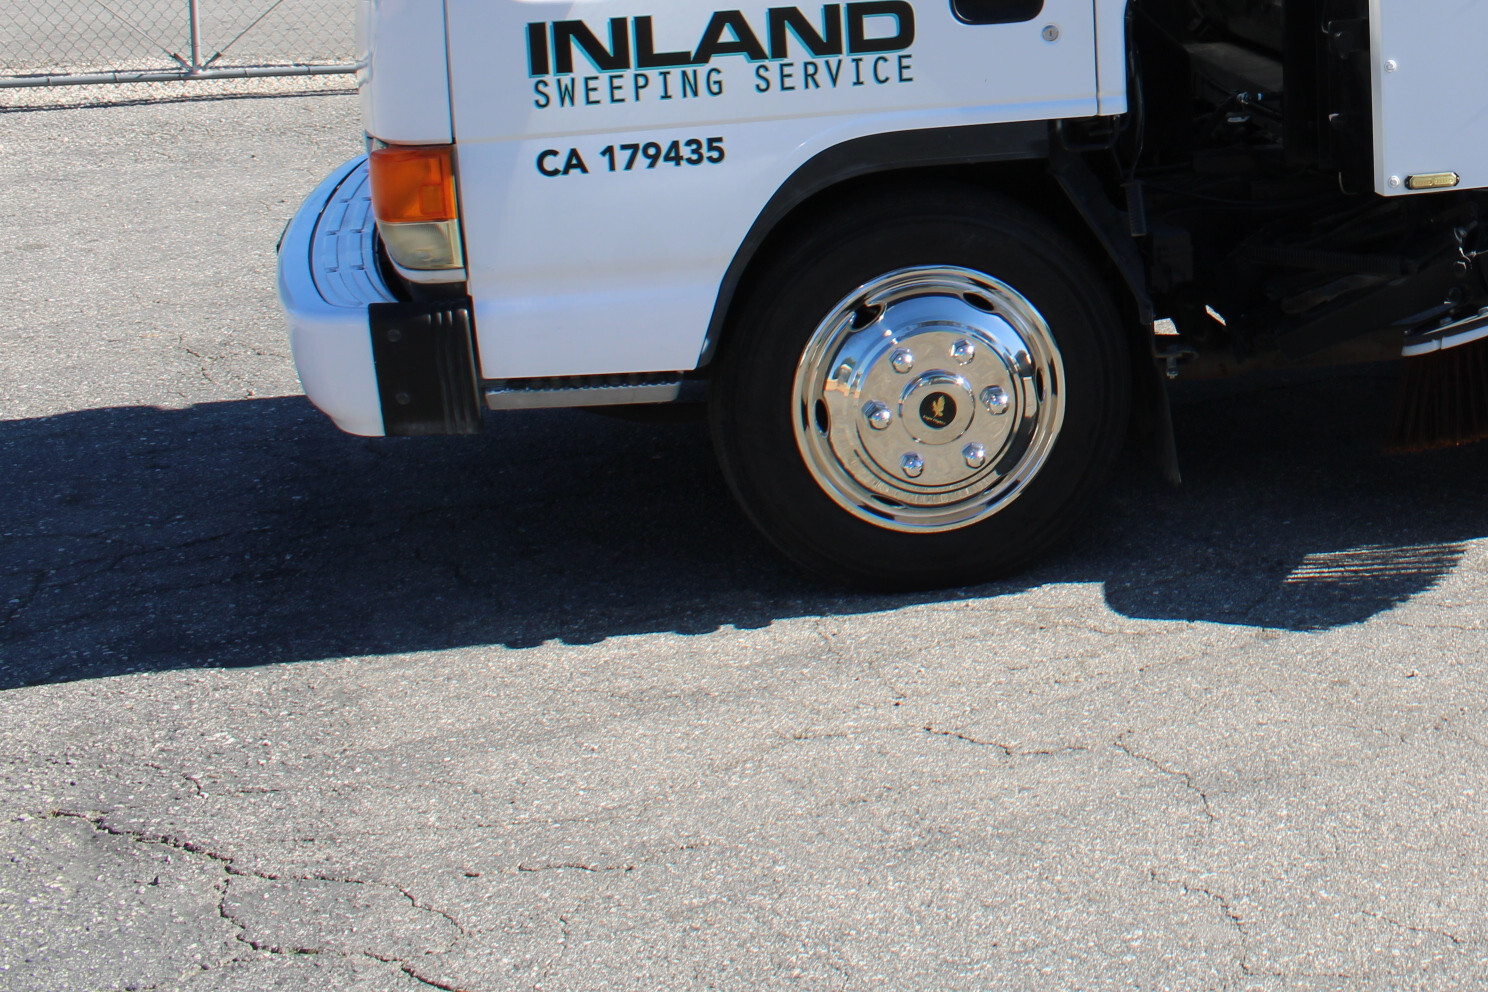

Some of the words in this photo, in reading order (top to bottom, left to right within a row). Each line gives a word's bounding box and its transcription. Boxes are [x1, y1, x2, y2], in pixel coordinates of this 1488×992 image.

[525, 0, 916, 78] INLAND
[533, 68, 724, 109] SWEEPING
[755, 54, 915, 93] SERVICE
[536, 148, 589, 178] CA
[599, 137, 727, 172] 179435
